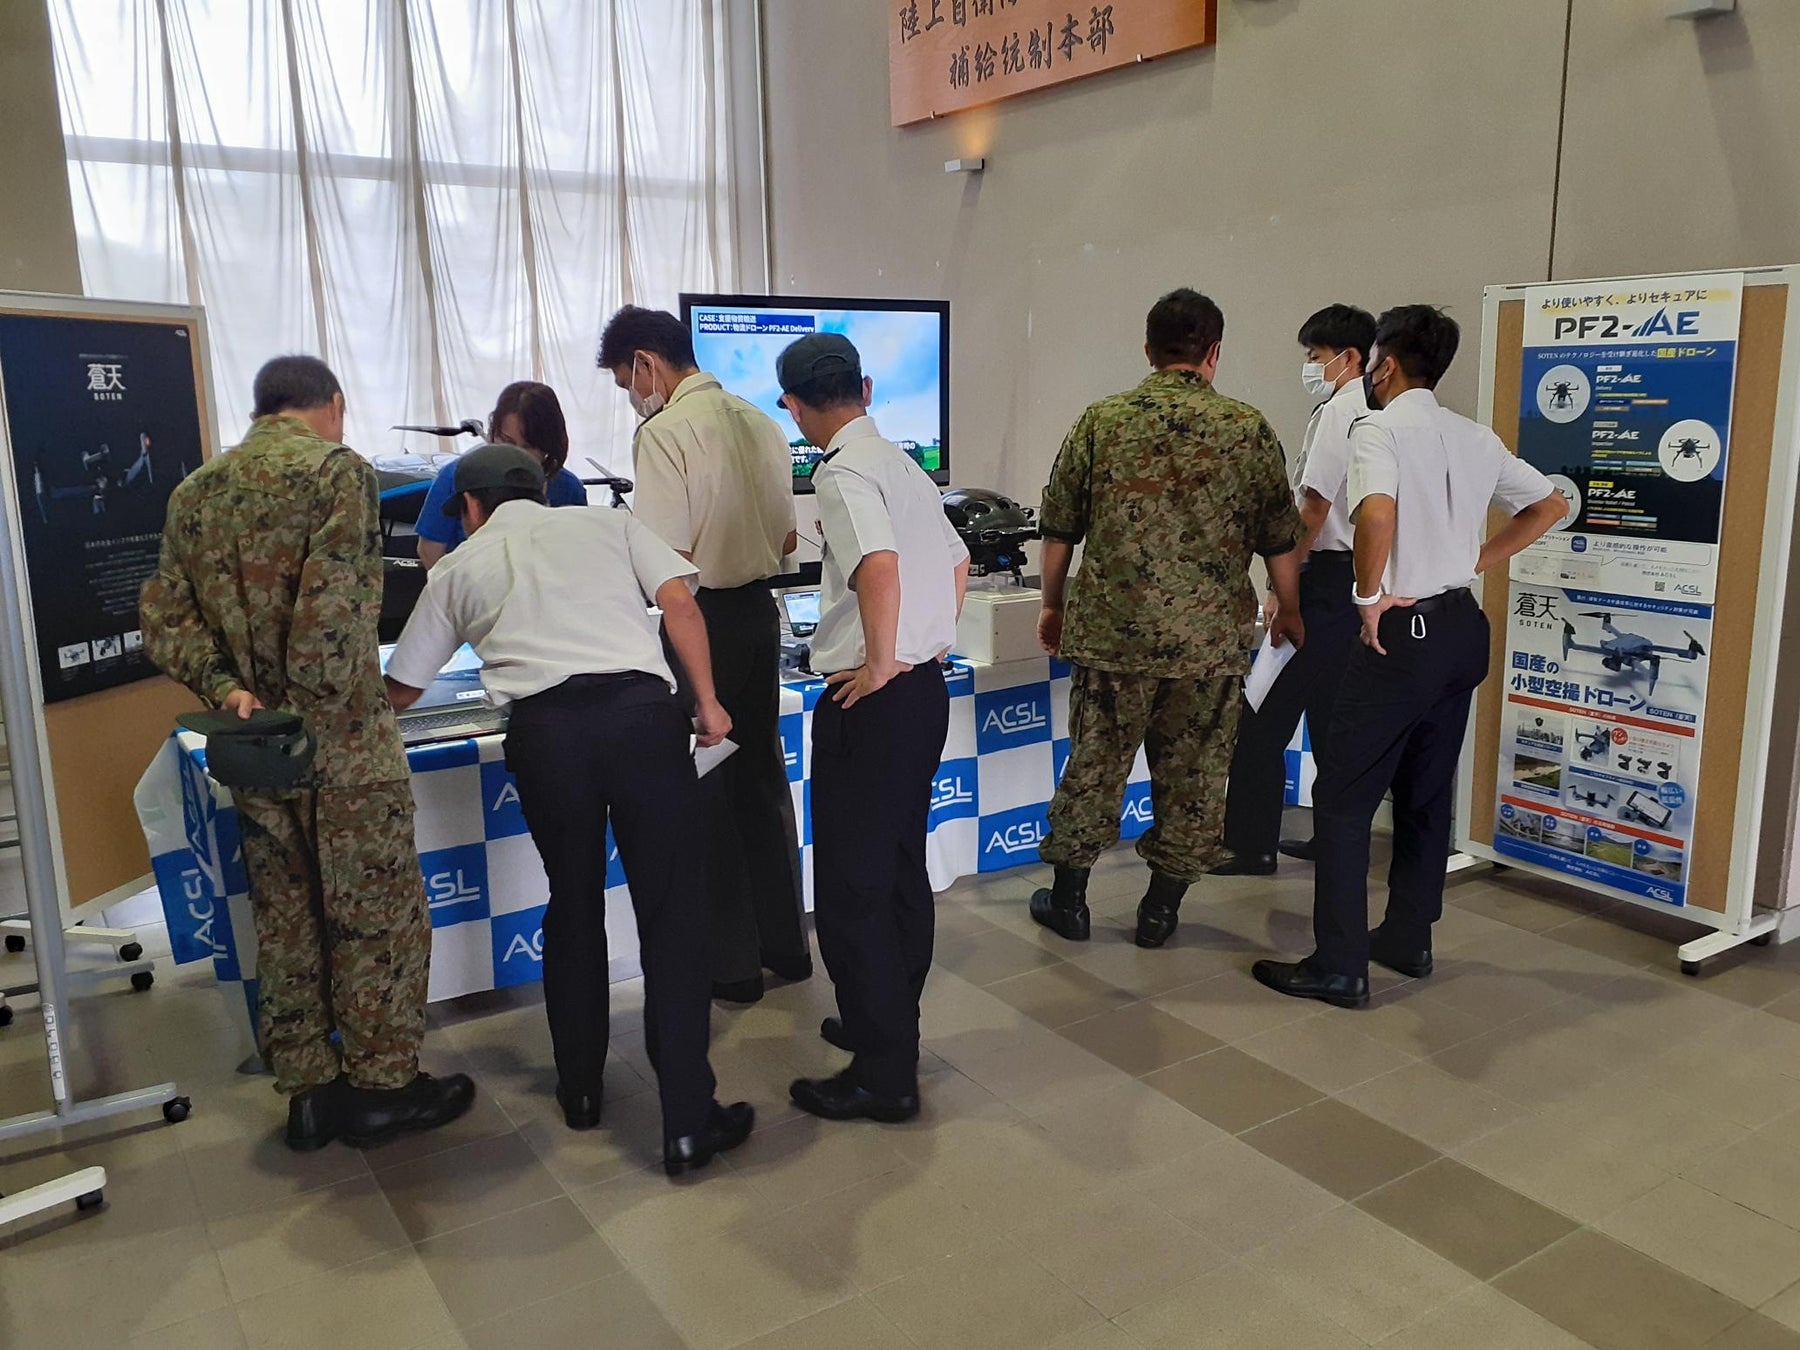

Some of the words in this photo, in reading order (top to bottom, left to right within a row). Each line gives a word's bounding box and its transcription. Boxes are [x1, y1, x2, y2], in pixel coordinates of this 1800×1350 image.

[899, 0, 1018, 44] 陸上自
[949, 4, 1114, 89] 補給統制本部
[769, 324, 789, 333] PF2-AE
[1554, 306, 1700, 340] PF2-AE
[87, 363, 127, 390] 蒼天
[1595, 373, 1642, 384] PF2-AE
[93, 392, 123, 401] SOTEN
[1591, 429, 1640, 440] PF2-AE
[1588, 488, 1637, 499] PF2-AE
[1673, 584, 1702, 597] ACSL
[1513, 592, 1562, 621] 蒼天
[1518, 619, 1553, 630] SOTEN
[1512, 651, 1560, 675] 国産の
[982, 701, 1046, 734] ACSL
[985, 821, 1046, 854] ACSL
[1645, 886, 1674, 902] ACSL
